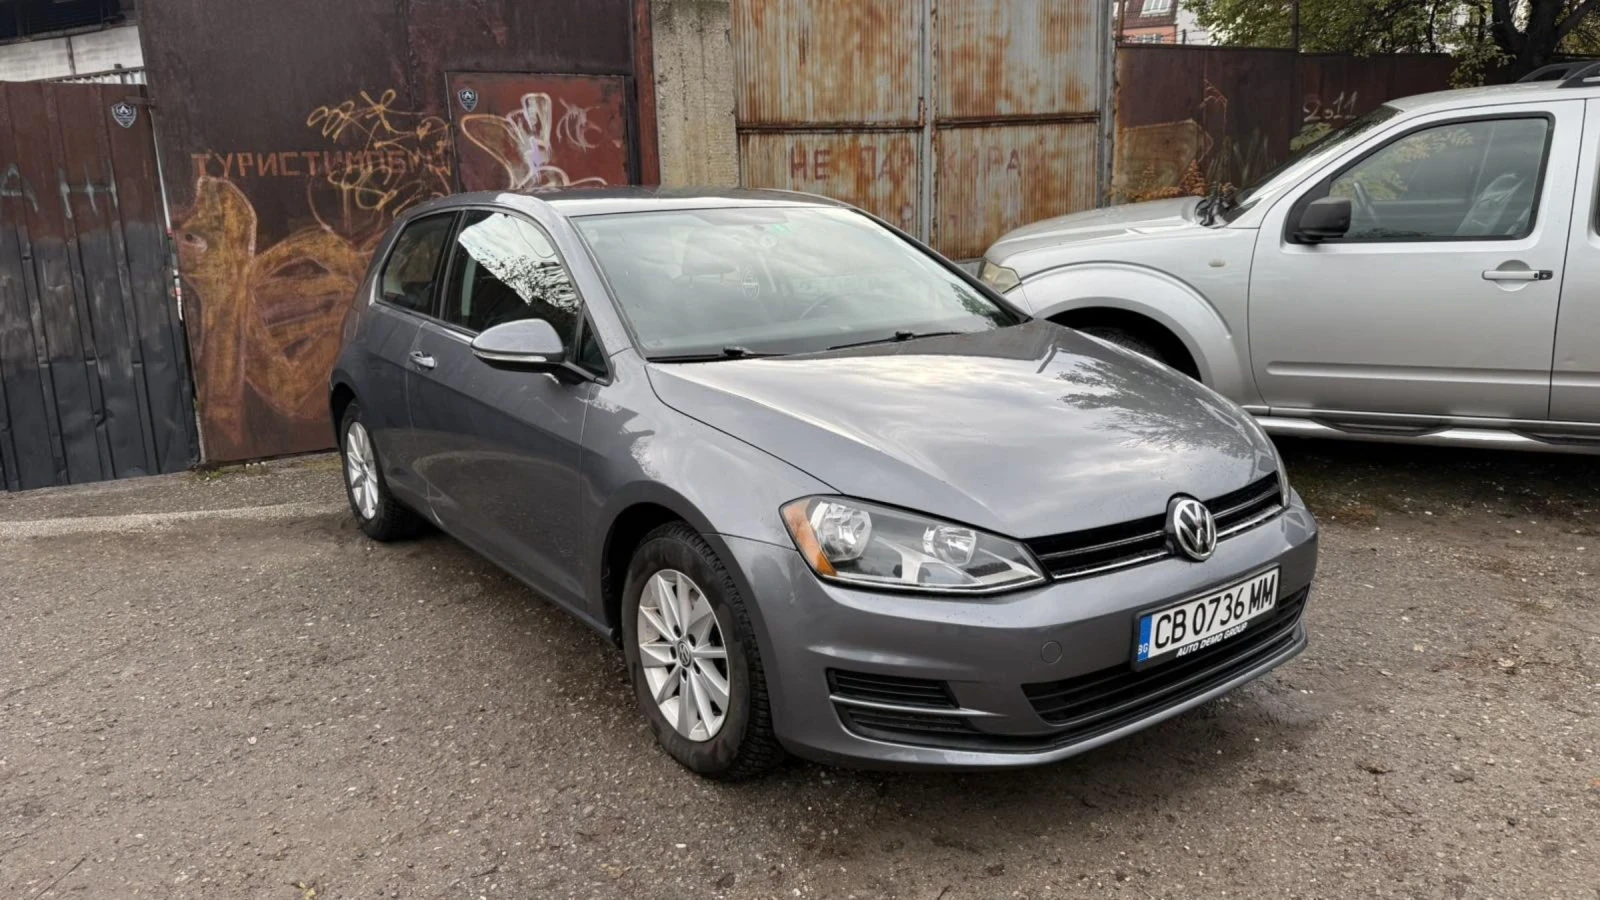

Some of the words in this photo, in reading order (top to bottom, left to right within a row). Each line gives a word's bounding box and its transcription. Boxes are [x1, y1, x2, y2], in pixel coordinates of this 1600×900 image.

[791, 145, 831, 182] НЕ
[1154, 608, 1187, 649] CB
[1192, 587, 1245, 636] 0736
[1248, 574, 1276, 615] MM
[1175, 641, 1199, 658] AUTO
[1199, 632, 1224, 649] DEMO
[1223, 621, 1249, 640] GROUP
